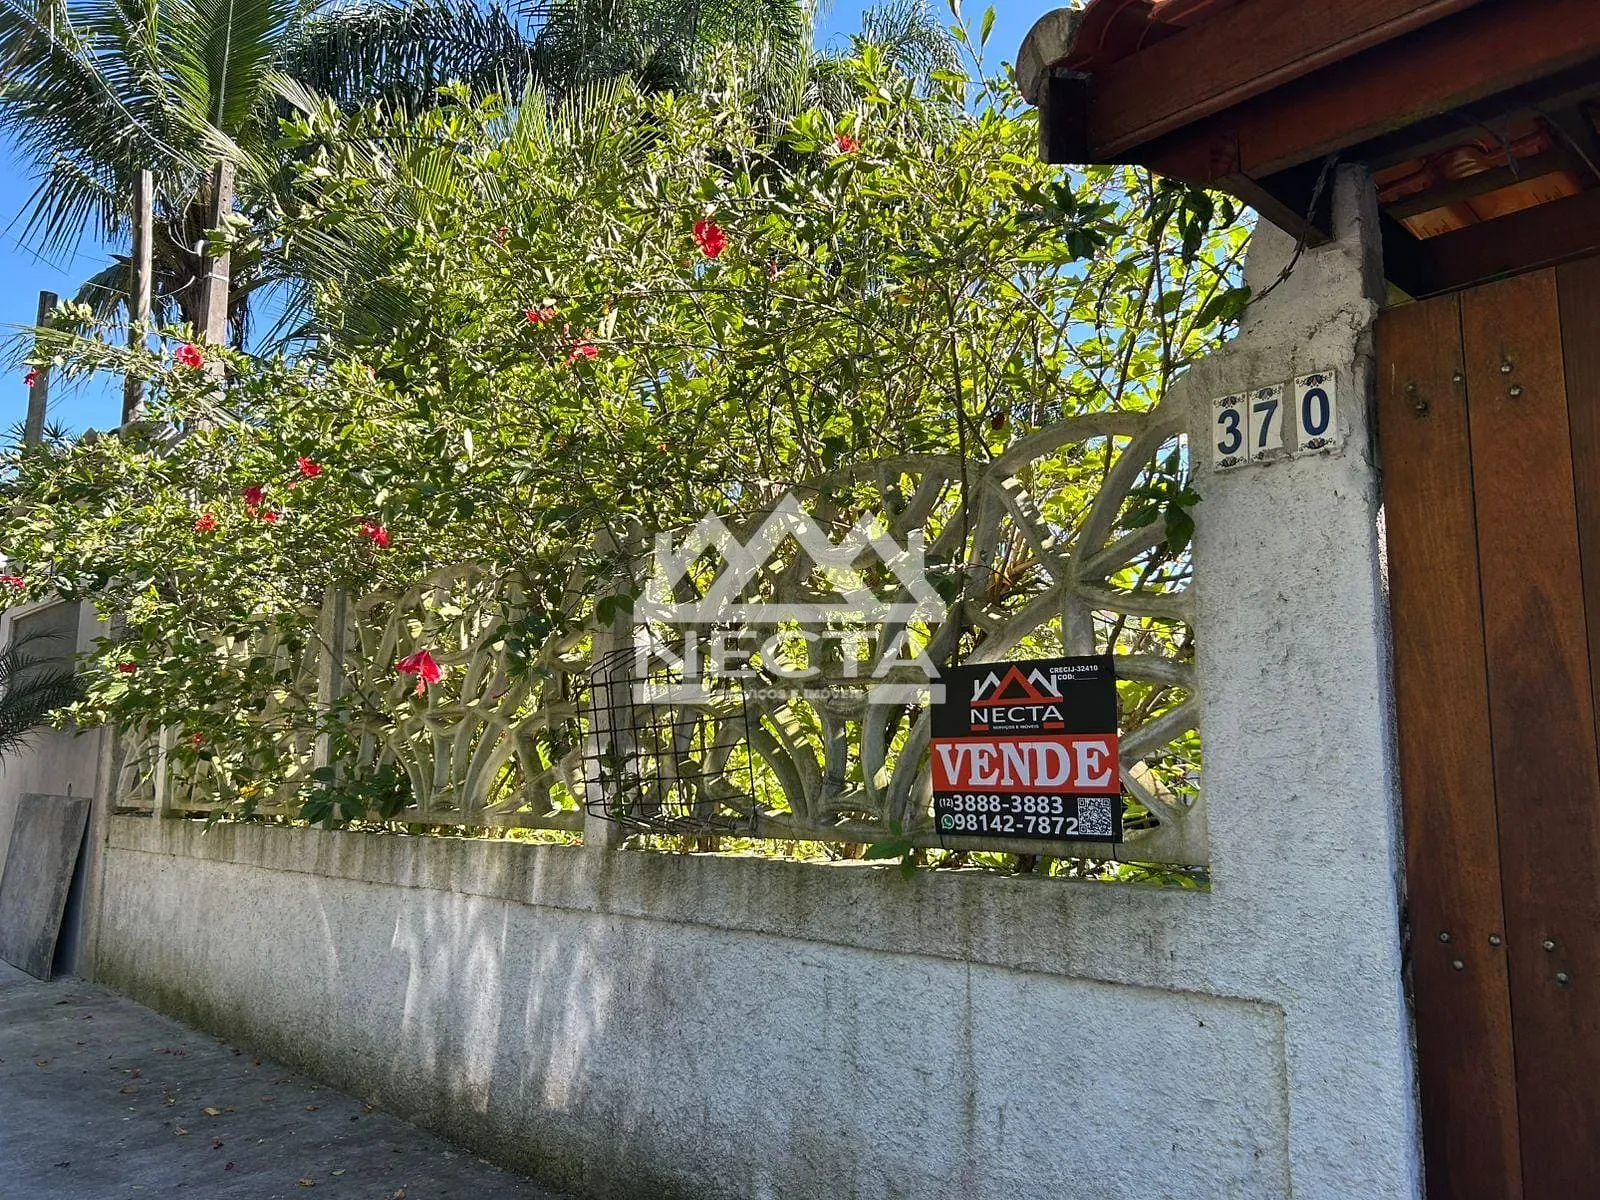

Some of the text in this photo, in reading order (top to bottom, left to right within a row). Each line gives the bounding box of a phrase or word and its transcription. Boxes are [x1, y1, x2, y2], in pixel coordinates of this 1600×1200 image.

[1217, 388, 1330, 455] 370
[970, 705, 1064, 724] NECTA
[935, 740, 1113, 787] VENDE
[954, 813, 1079, 835] 98142-7872
